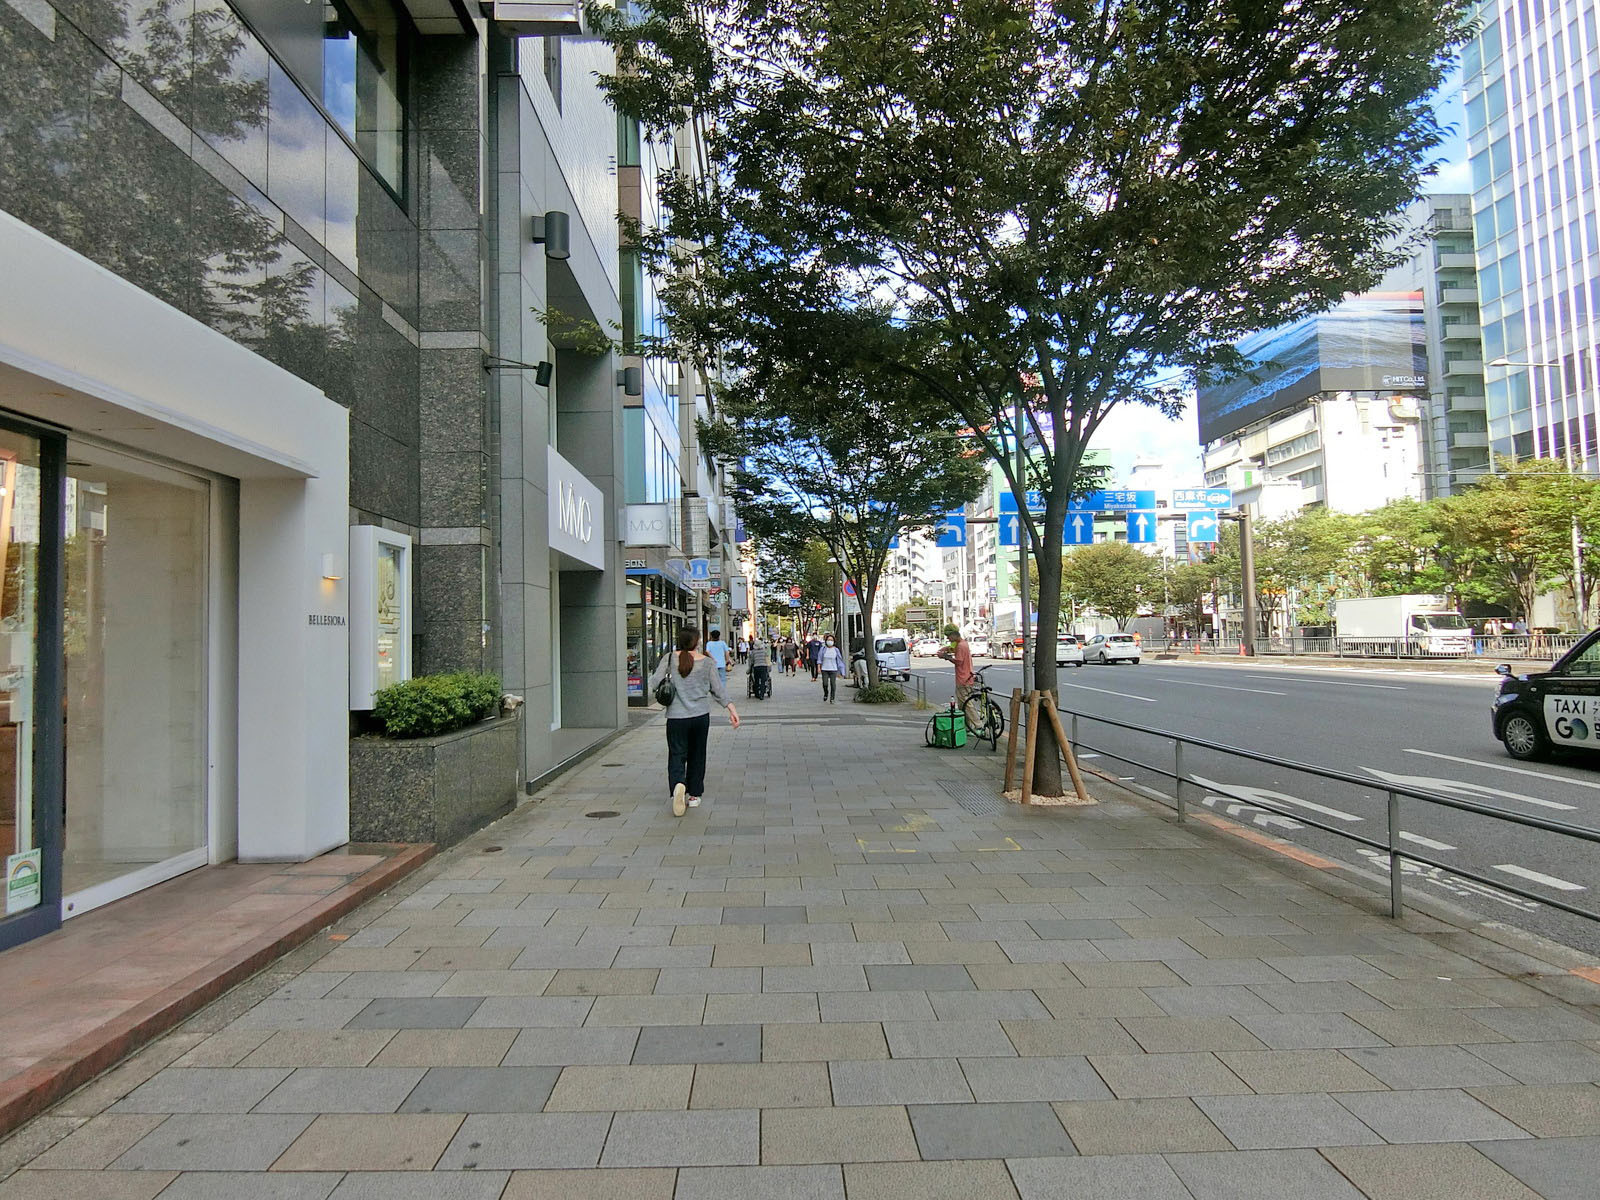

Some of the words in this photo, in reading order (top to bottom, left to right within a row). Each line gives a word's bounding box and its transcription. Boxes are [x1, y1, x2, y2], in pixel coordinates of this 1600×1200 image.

[1103, 492, 1137, 503] 三宅坂
[559, 480, 592, 544] MMC
[631, 519, 664, 532] MMC
[309, 615, 346, 626] BELLESIORA
[1554, 698, 1586, 715] TAXI
